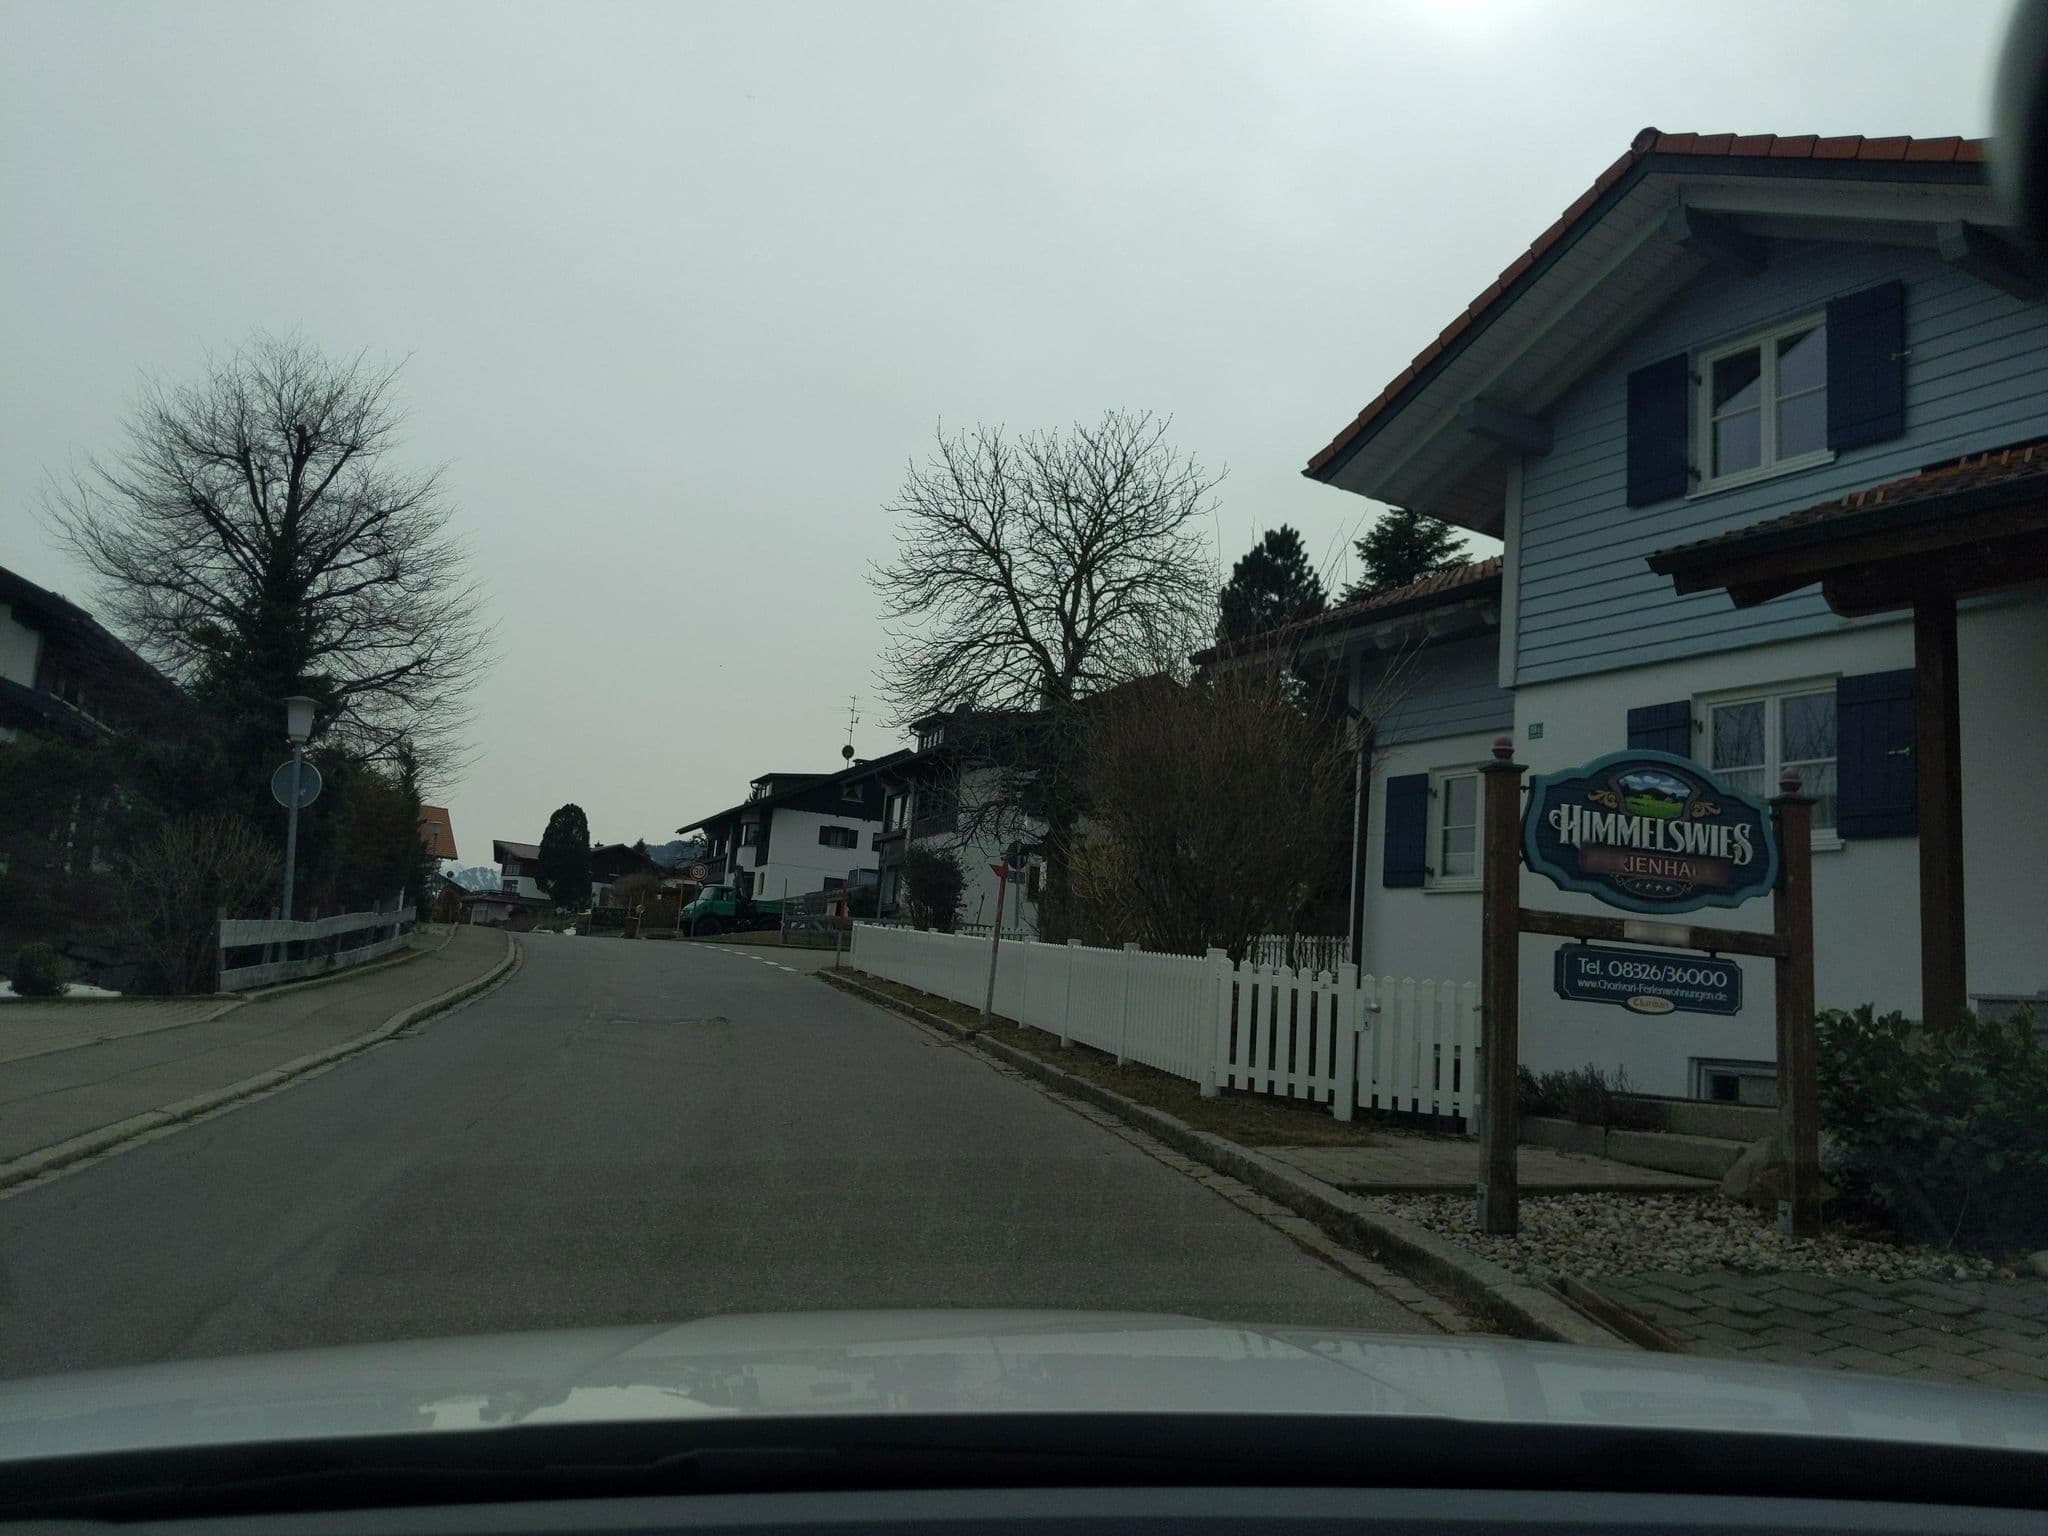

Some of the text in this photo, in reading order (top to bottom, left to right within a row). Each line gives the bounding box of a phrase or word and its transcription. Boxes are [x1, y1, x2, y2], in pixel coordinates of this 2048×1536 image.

[1548, 803, 1753, 865] HIMMELSWIES
[694, 867, 704, 876] 30
[1577, 957, 1728, 987] Tel. 08326/36000
